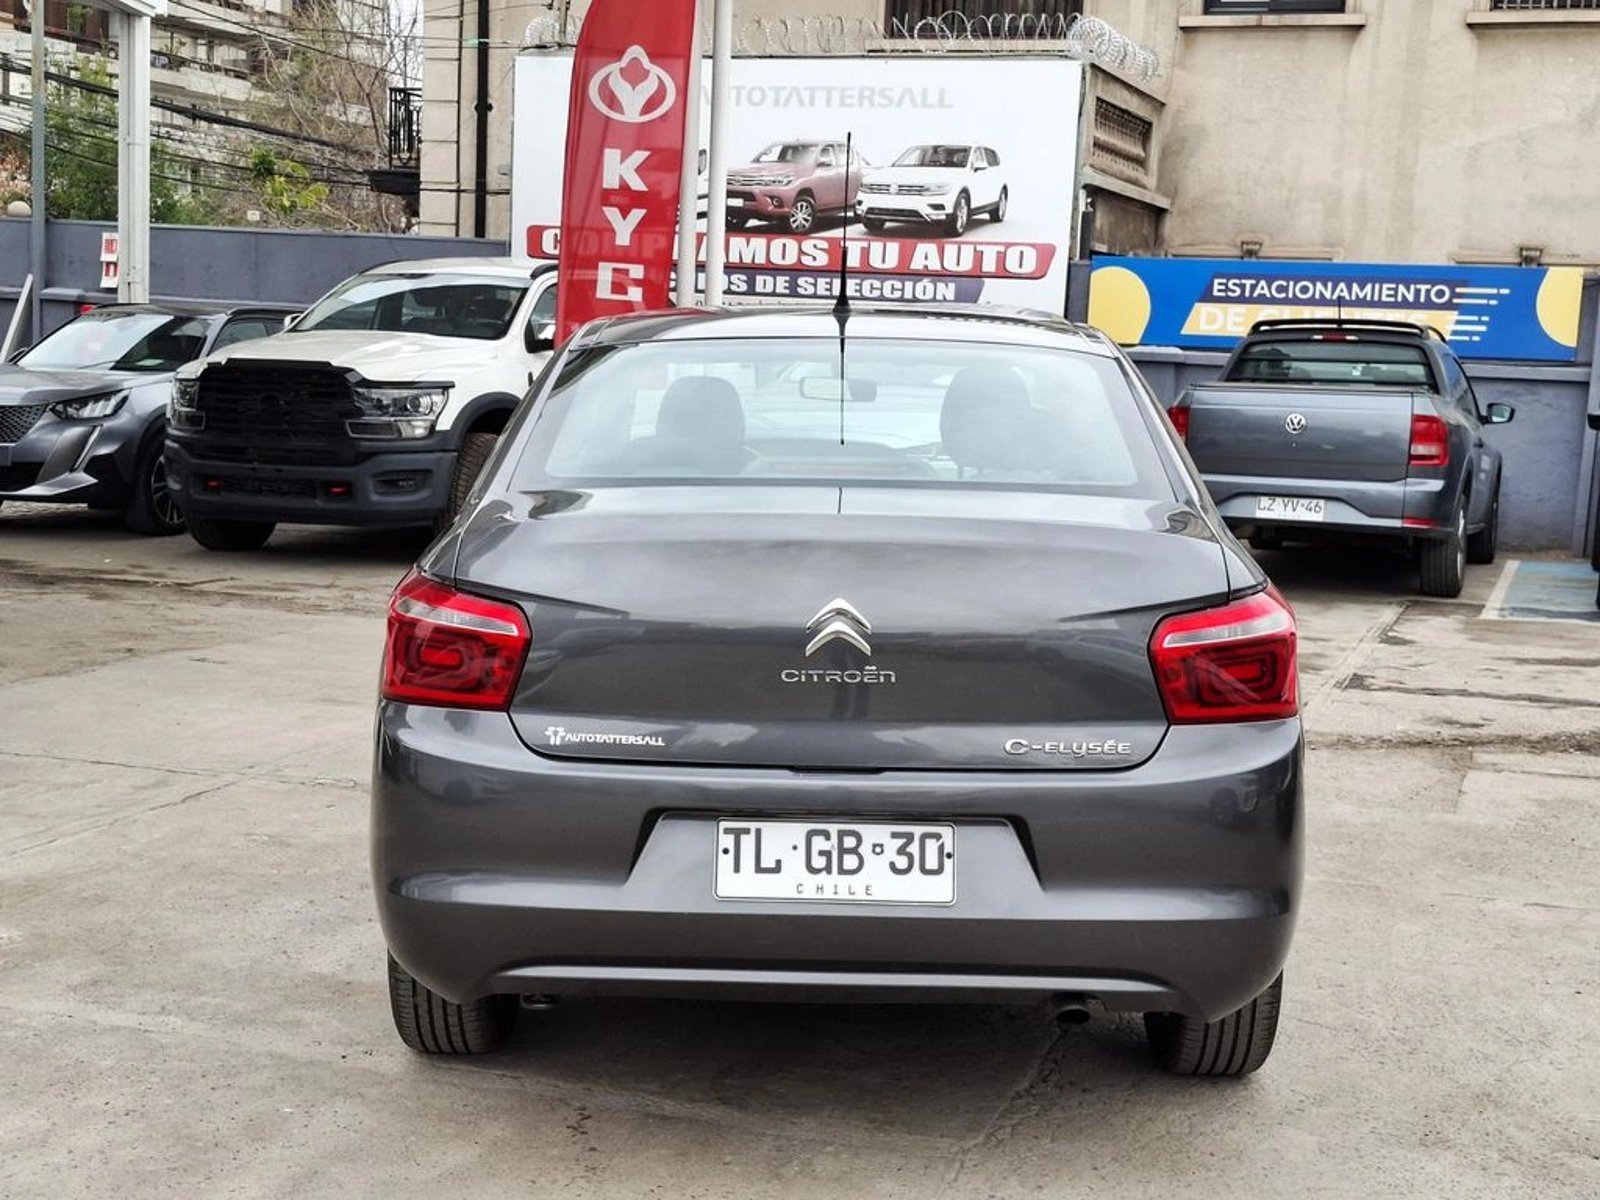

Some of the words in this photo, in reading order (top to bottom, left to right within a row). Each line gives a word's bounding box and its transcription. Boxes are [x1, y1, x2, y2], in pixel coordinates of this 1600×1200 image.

[700, 85, 954, 109] TOTATTERSALL
[840, 240, 899, 269] TU
[909, 243, 1037, 274] AUTO
[754, 275, 790, 294] DE
[1212, 278, 1450, 304] ESTACIONAMIENTO
[1200, 307, 1247, 331] DE
[781, 665, 896, 683] CITROËN
[565, 733, 666, 746] AUTOTATTERSALL
[1004, 739, 1132, 758] C-ELYSÉE
[796, 883, 873, 896] CHILE
